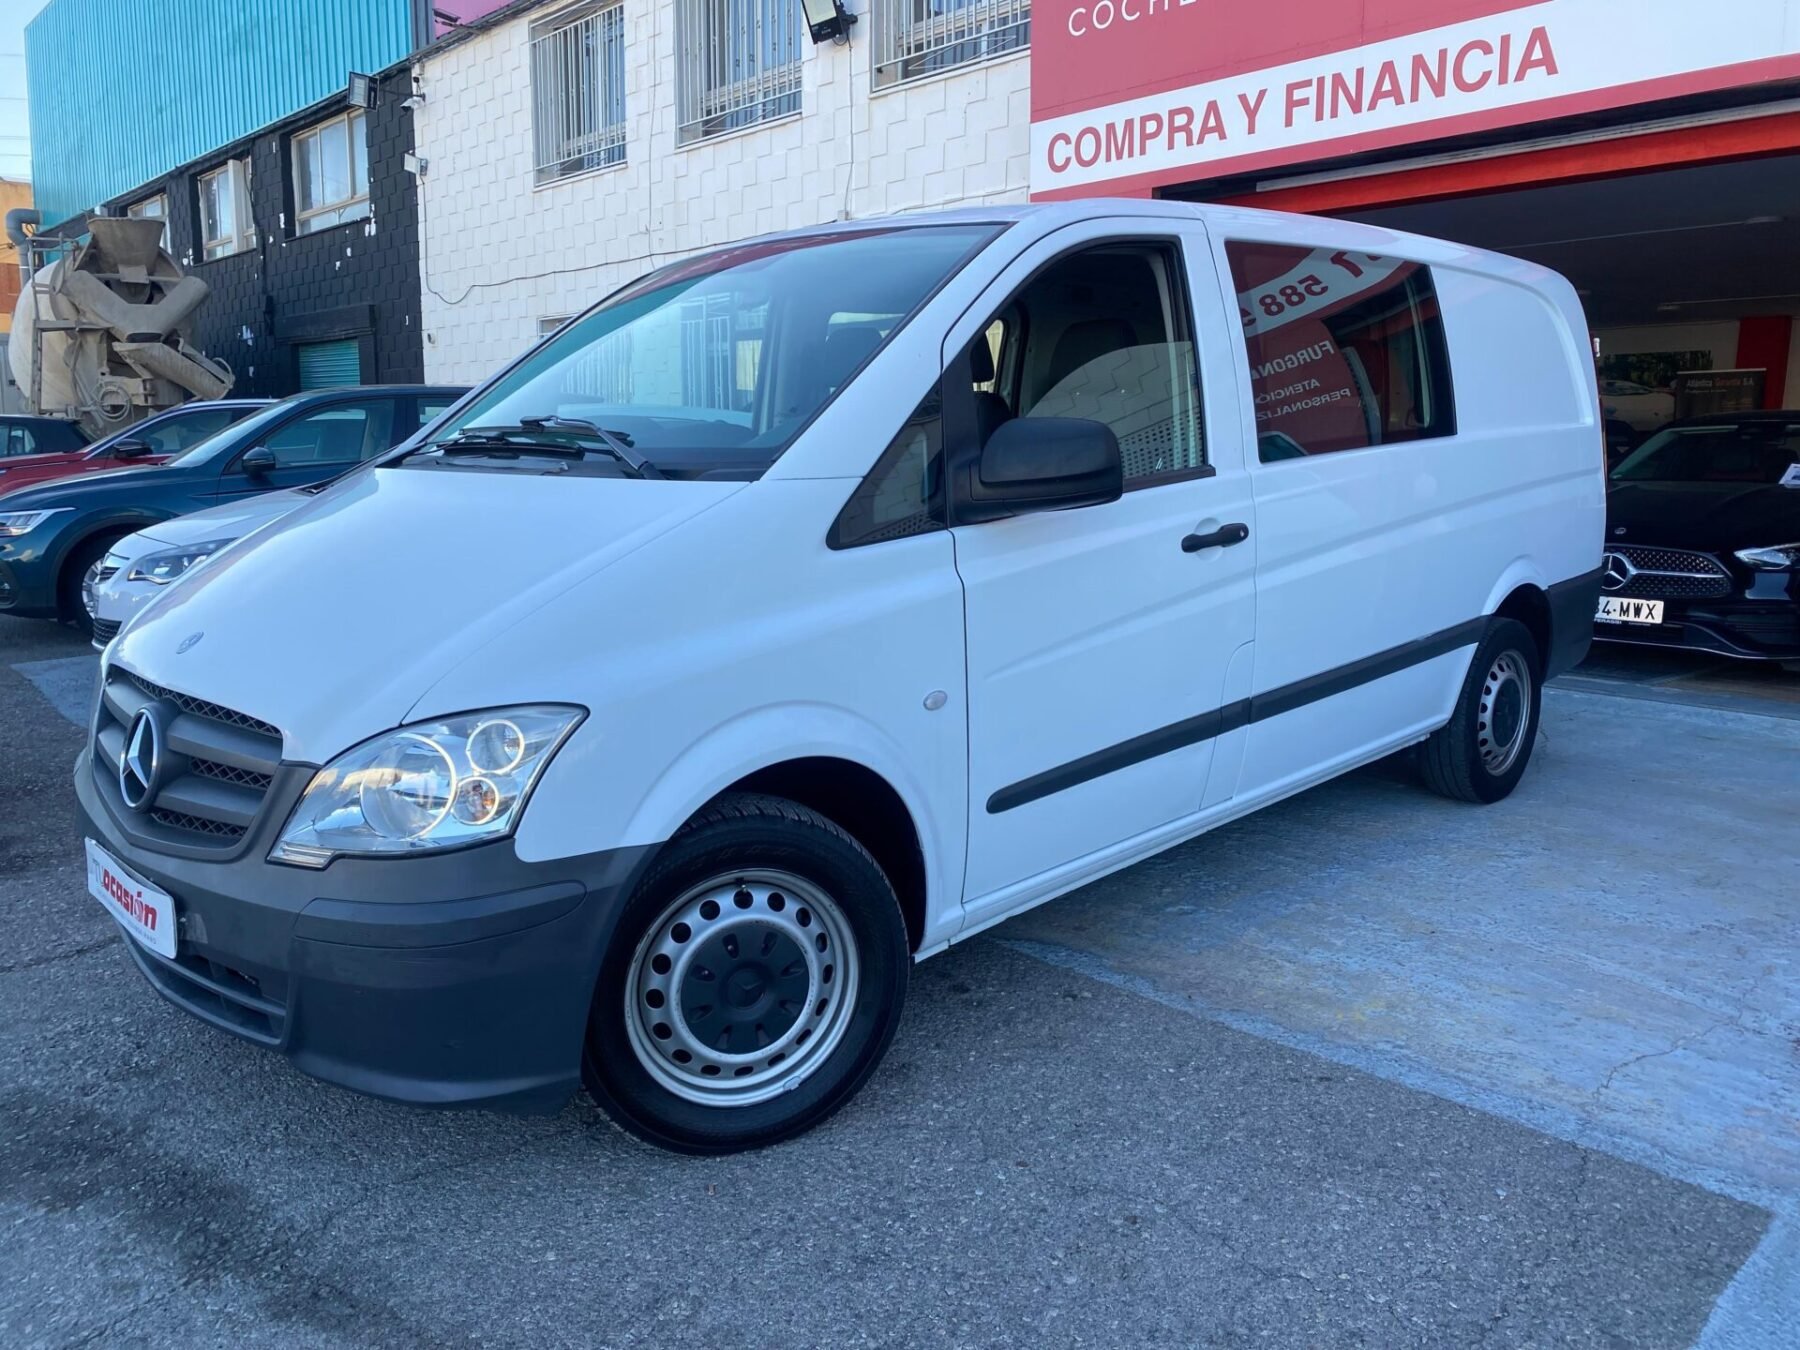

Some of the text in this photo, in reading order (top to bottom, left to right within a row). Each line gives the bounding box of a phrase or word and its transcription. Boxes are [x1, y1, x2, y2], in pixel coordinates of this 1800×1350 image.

[1047, 26, 1559, 174] COMPRA Y FINANCIA
